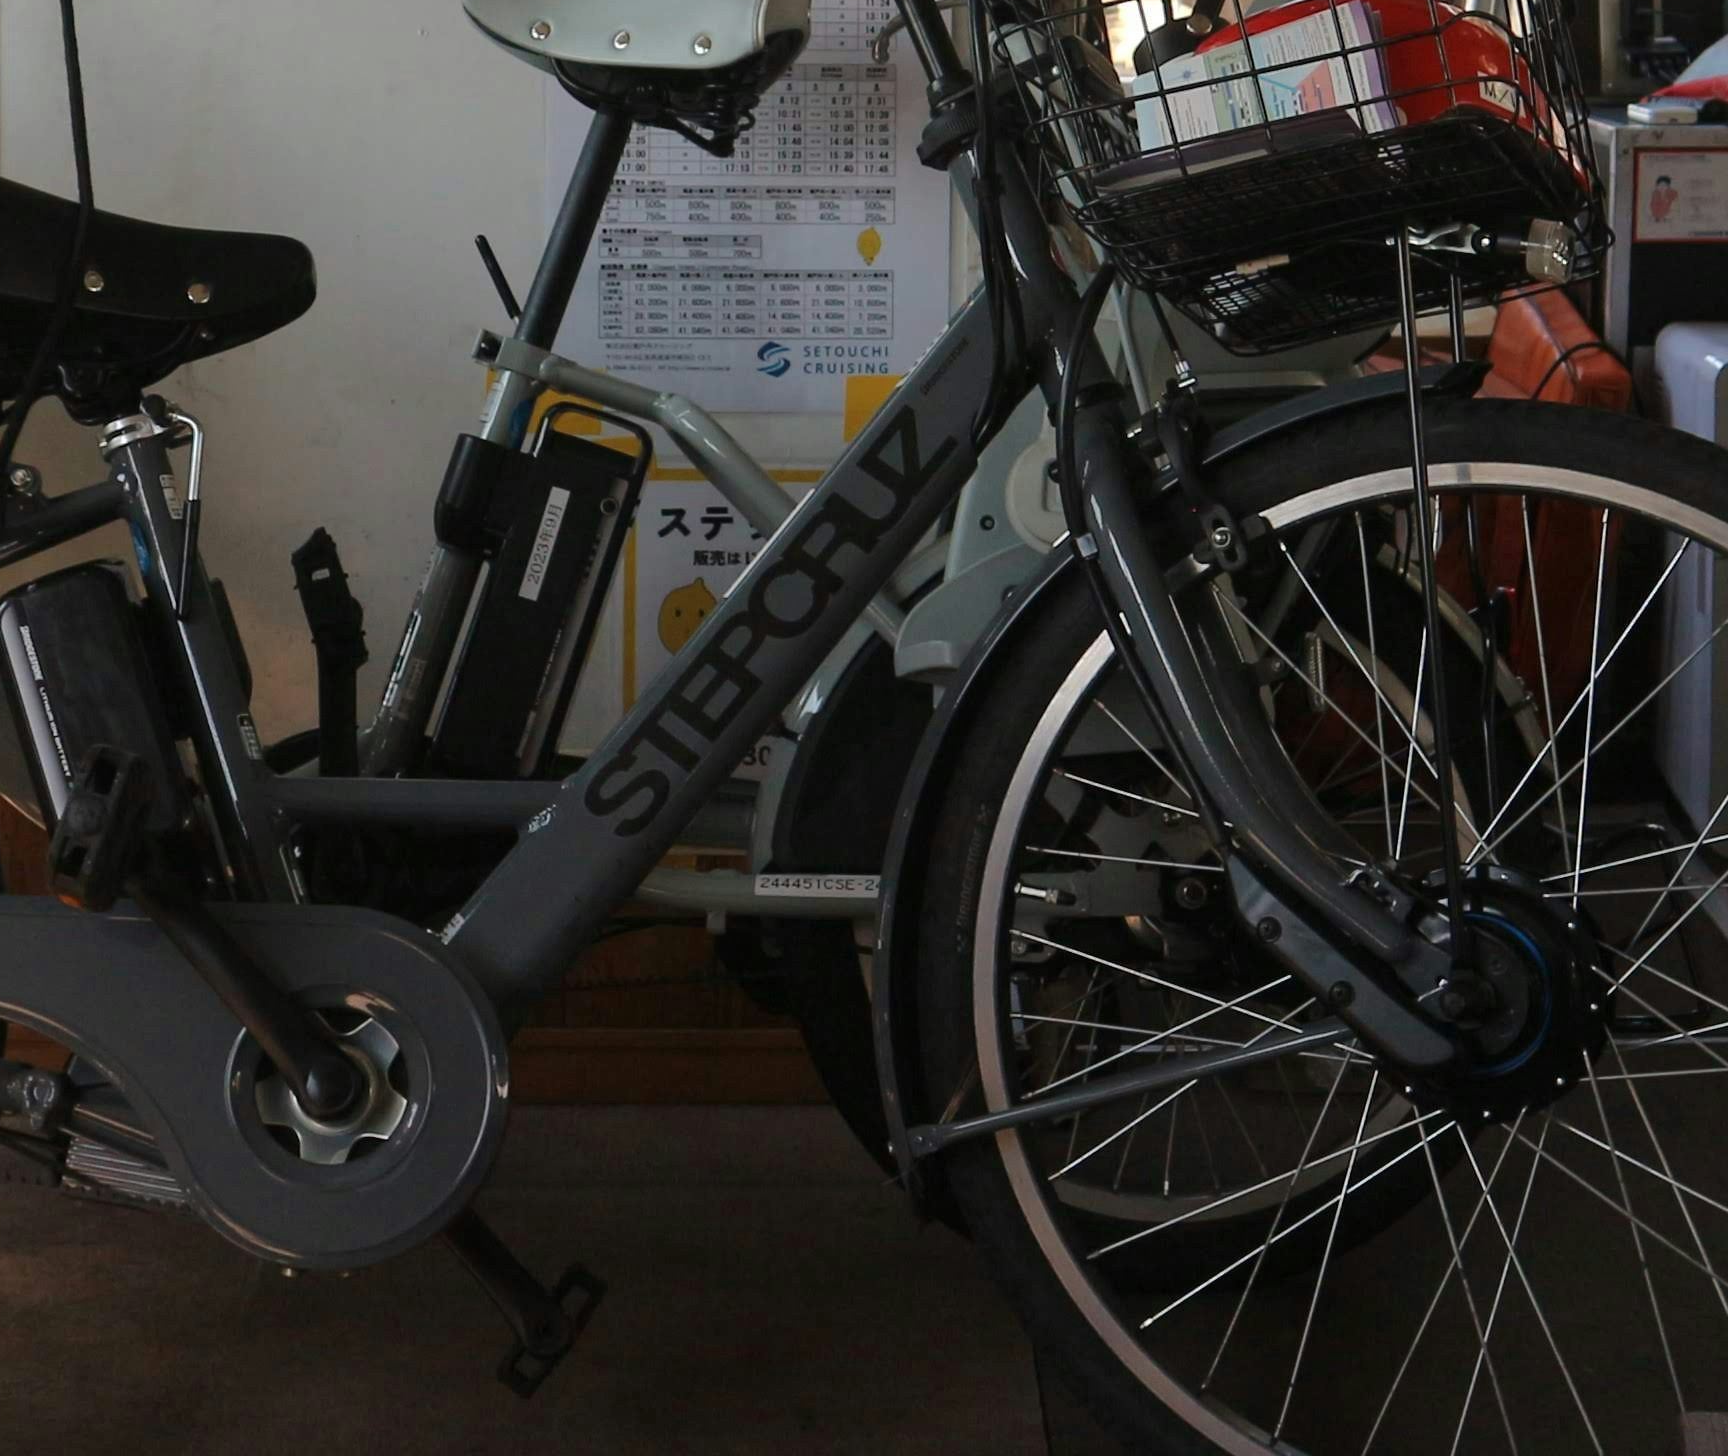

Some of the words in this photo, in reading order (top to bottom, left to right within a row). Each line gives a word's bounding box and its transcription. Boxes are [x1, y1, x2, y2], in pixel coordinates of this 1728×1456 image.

[803, 346, 888, 357] SETOUCHI
[803, 363, 888, 374] CRUISING
[527, 503, 562, 585] 2023年9月
[19, 624, 44, 681] BRIDGESTONE
